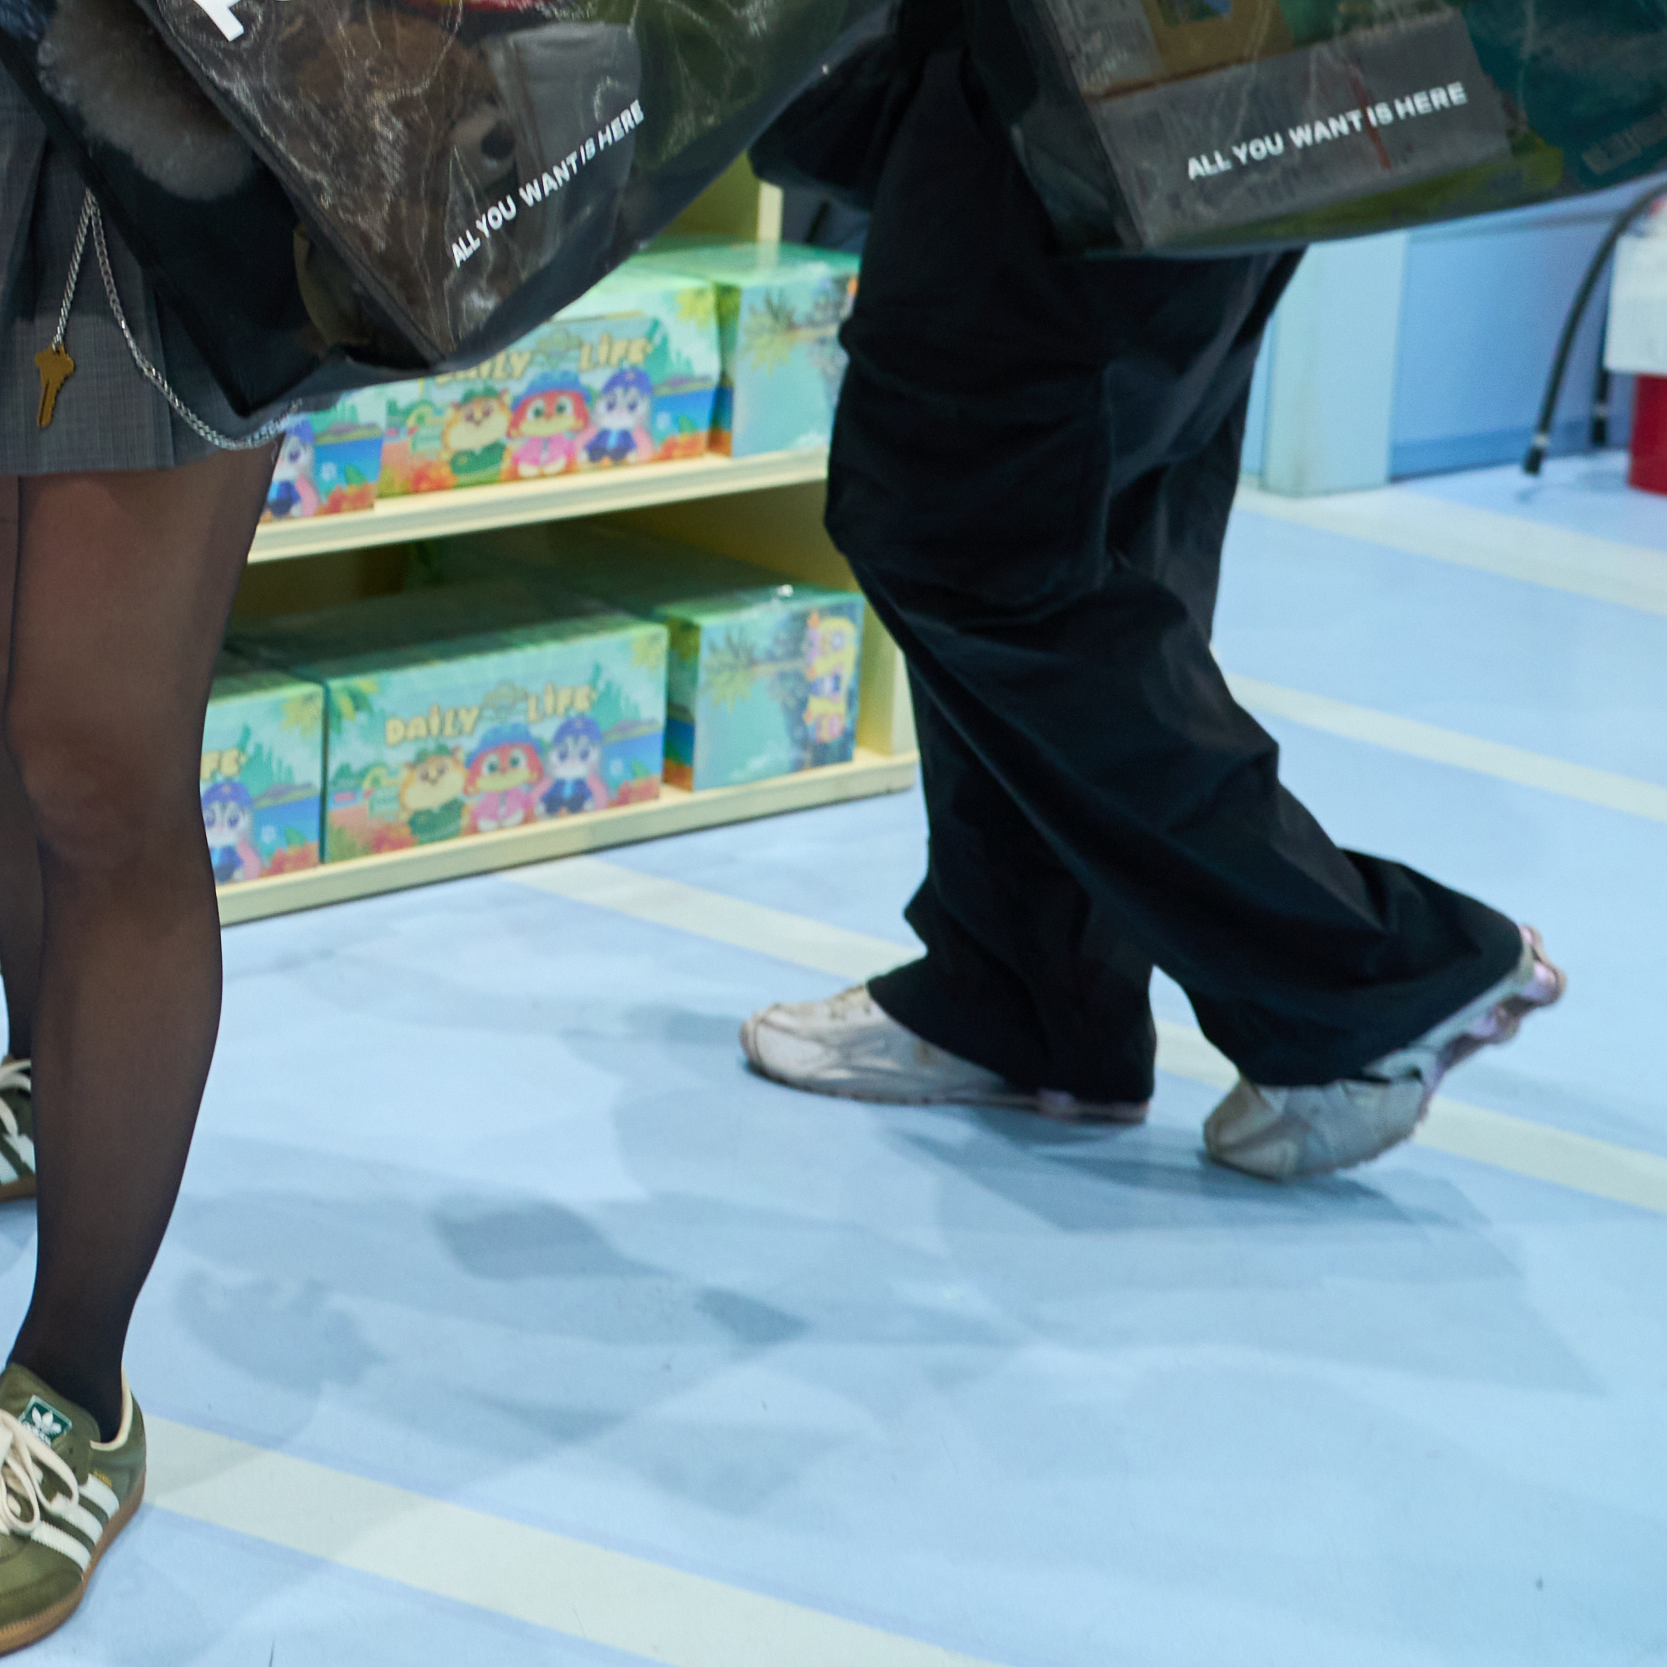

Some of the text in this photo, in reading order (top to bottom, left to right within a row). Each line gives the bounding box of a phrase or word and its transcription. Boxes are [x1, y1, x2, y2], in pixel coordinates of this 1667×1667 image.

[451, 99, 645, 269] ALL YOU WANT IS HERE
[1187, 80, 1468, 180] ALL YOU WANT IS HERE
